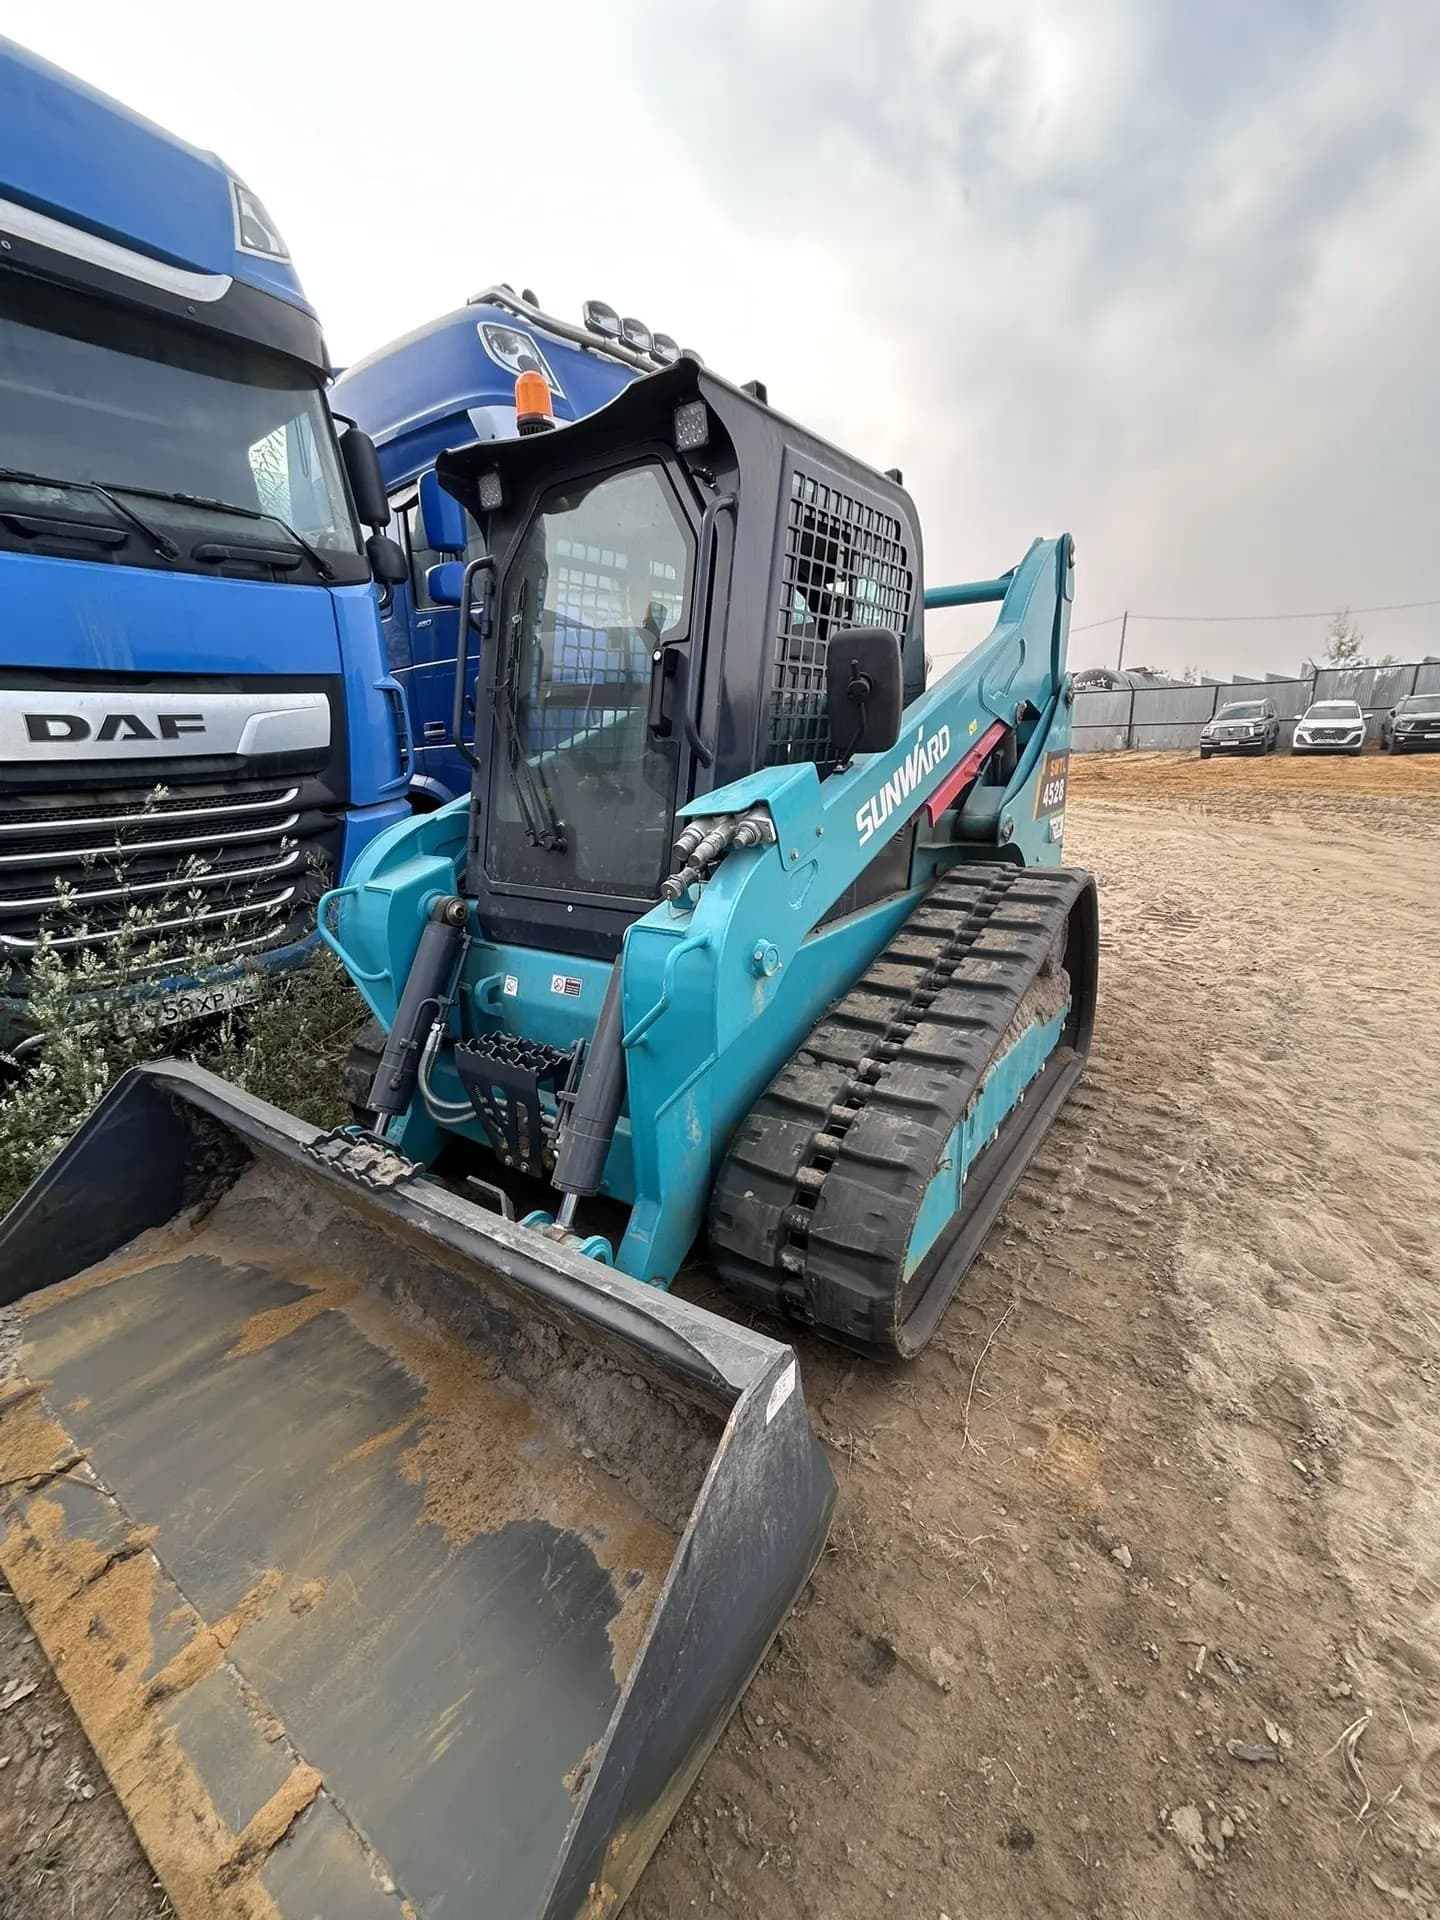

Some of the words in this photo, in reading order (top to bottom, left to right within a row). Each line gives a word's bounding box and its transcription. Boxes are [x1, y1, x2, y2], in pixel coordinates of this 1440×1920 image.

[24, 714, 206, 741] DAF
[856, 724, 950, 847] SUNWARD
[1043, 778, 1065, 807] 4528
